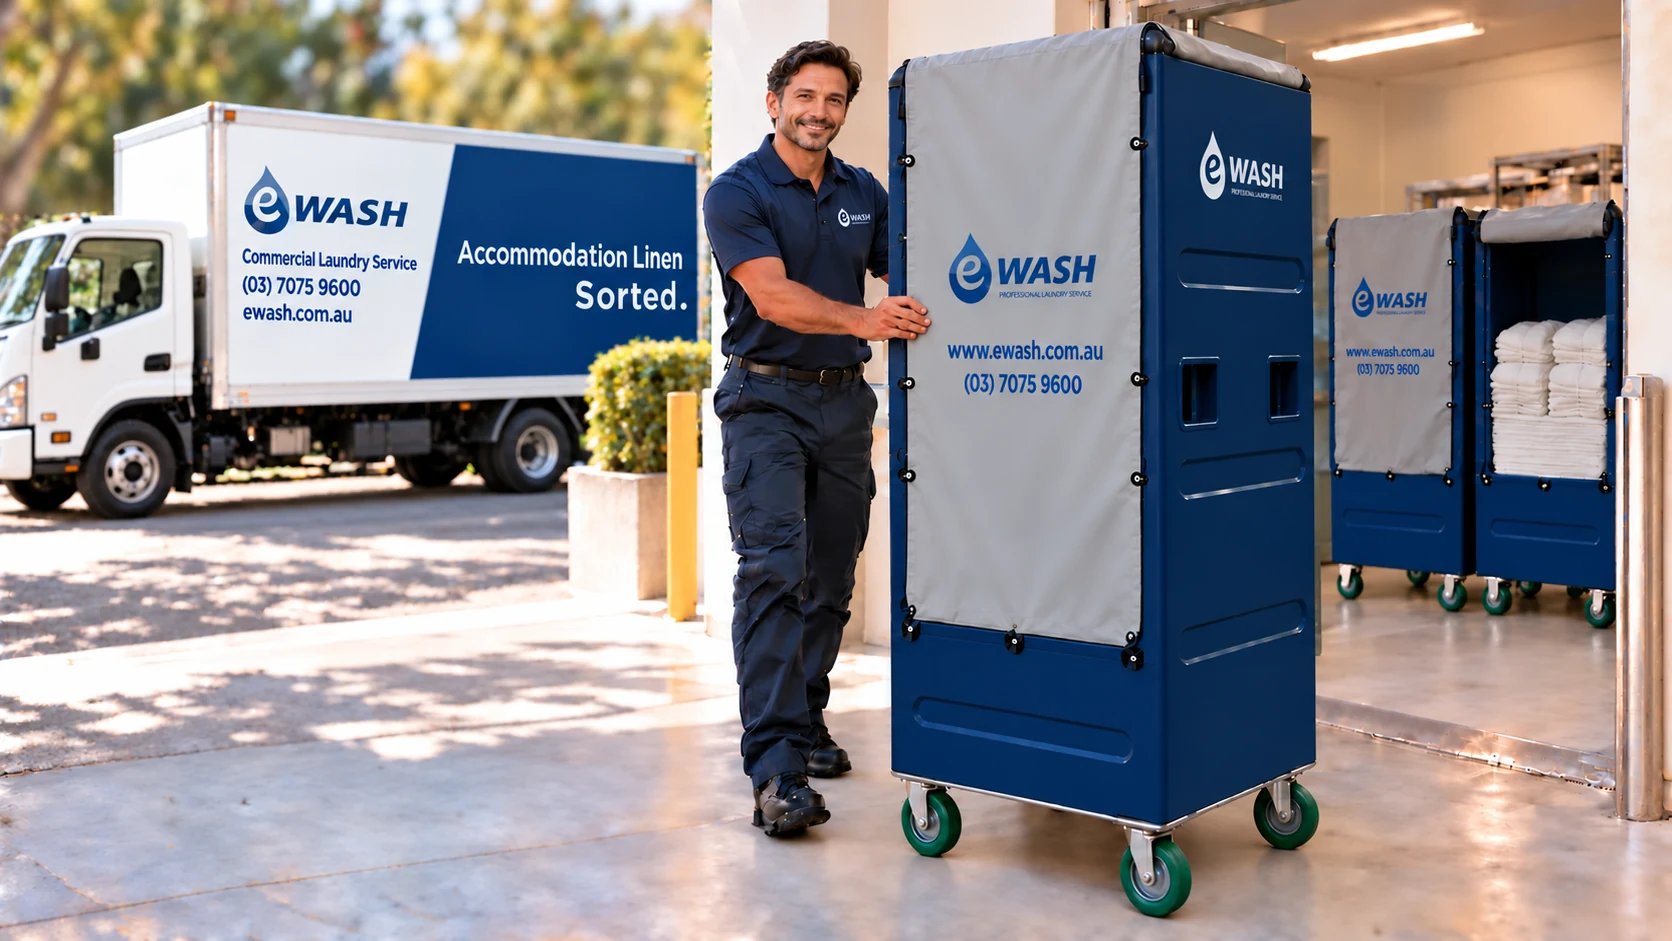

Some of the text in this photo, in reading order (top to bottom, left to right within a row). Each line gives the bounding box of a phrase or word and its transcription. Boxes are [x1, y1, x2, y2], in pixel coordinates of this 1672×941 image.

[1229, 156, 1283, 189] WASH
[295, 195, 408, 227] WASH
[242, 248, 417, 272] Commercial Laundry Service
[457, 240, 683, 270] Accommodation Linen
[998, 254, 1096, 285] WASH
[242, 275, 361, 296] (03) 7075 9600
[575, 280, 687, 310] Sorted.
[1376, 292, 1428, 308] WASH
[243, 303, 352, 323] ewash.com.au
[947, 340, 1103, 360] www.ewash.com.au
[1346, 346, 1435, 357] www.ewash.com.au
[1357, 363, 1420, 376] (03) 7075 9600
[964, 373, 1082, 395] (03) 7075 9600
